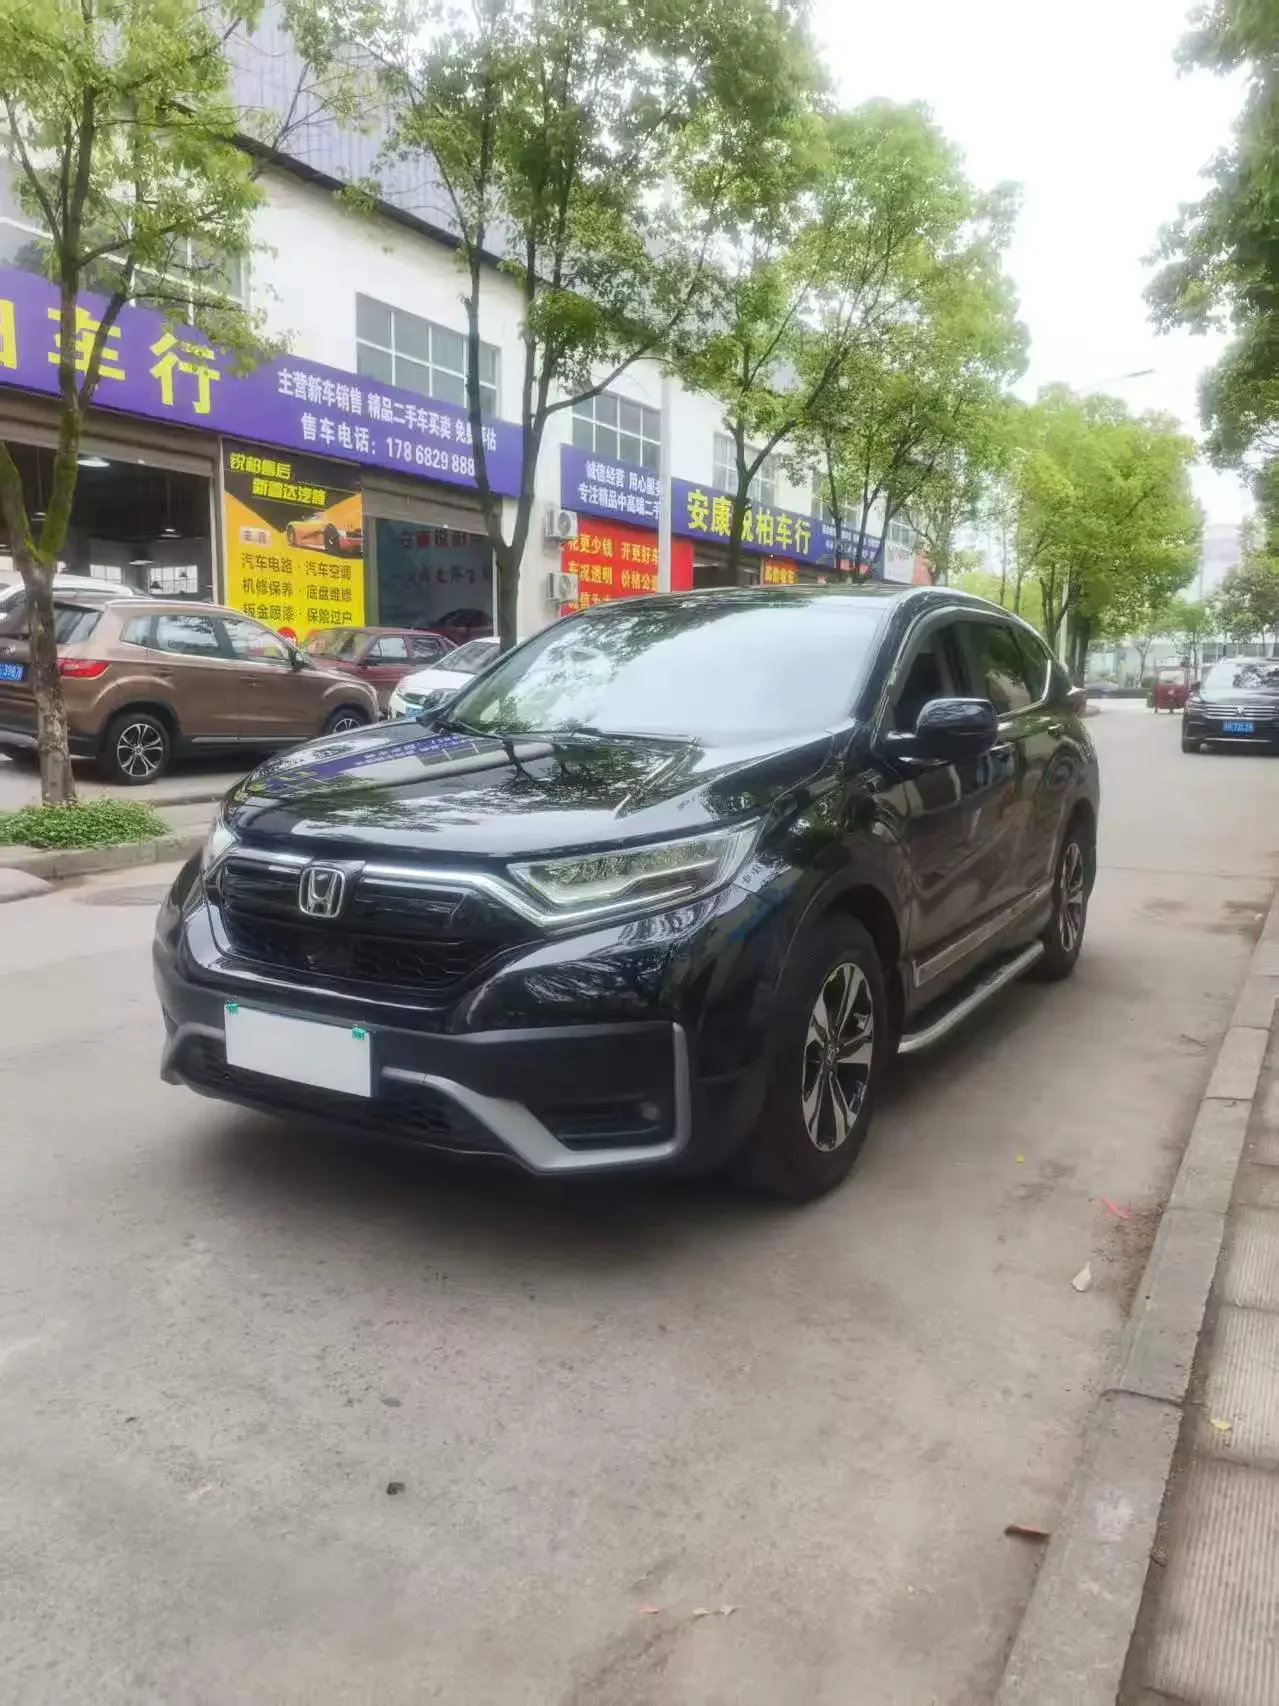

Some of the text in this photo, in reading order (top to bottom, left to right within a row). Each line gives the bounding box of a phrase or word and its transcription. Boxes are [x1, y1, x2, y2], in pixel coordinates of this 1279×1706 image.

[277, 368, 362, 416] 主营新车销售
[368, 391, 451, 439] 精品二手车买卖
[386, 437, 412, 462] 178
[415, 444, 450, 470] 6829
[586, 460, 625, 488] 诚信经营
[241, 552, 352, 581] 汽车电路 汽车空调
[242, 577, 294, 598] 机修保养
